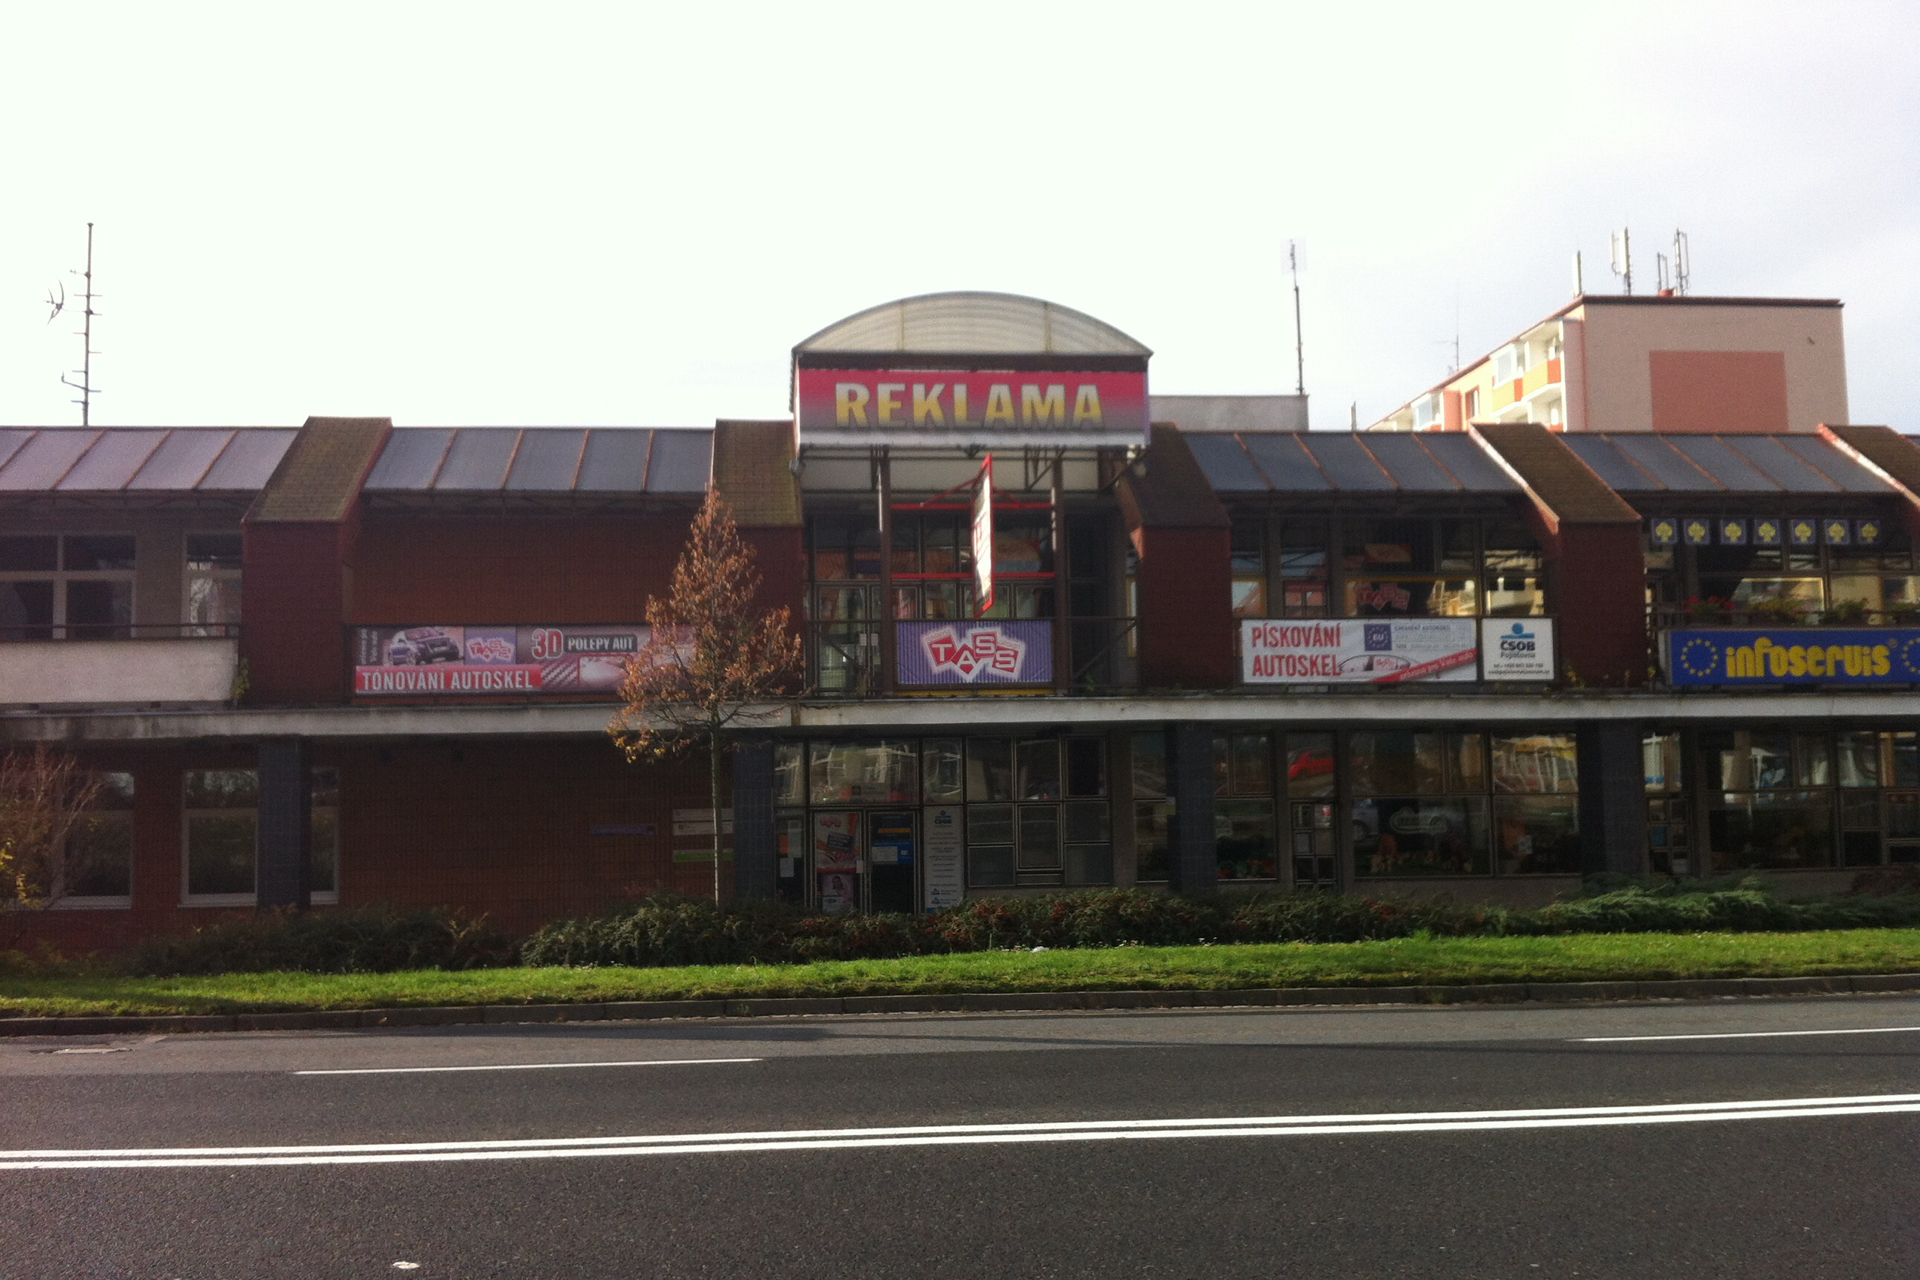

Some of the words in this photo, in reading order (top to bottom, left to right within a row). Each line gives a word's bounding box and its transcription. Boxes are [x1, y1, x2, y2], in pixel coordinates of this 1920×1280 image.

[835, 382, 1103, 429] REKLAMA
[532, 628, 564, 660] 3D
[568, 637, 609, 651] POLEPY
[612, 636, 634, 650] AUT
[1251, 622, 1341, 648] PÍSKOVÁNÍ
[1372, 633, 1384, 642] EU
[929, 633, 1018, 672] TASS
[1251, 654, 1342, 677] AUTOSKEL
[362, 668, 445, 691] TÓNOVÁNÍ
[450, 670, 534, 690] AUTOSKEL
